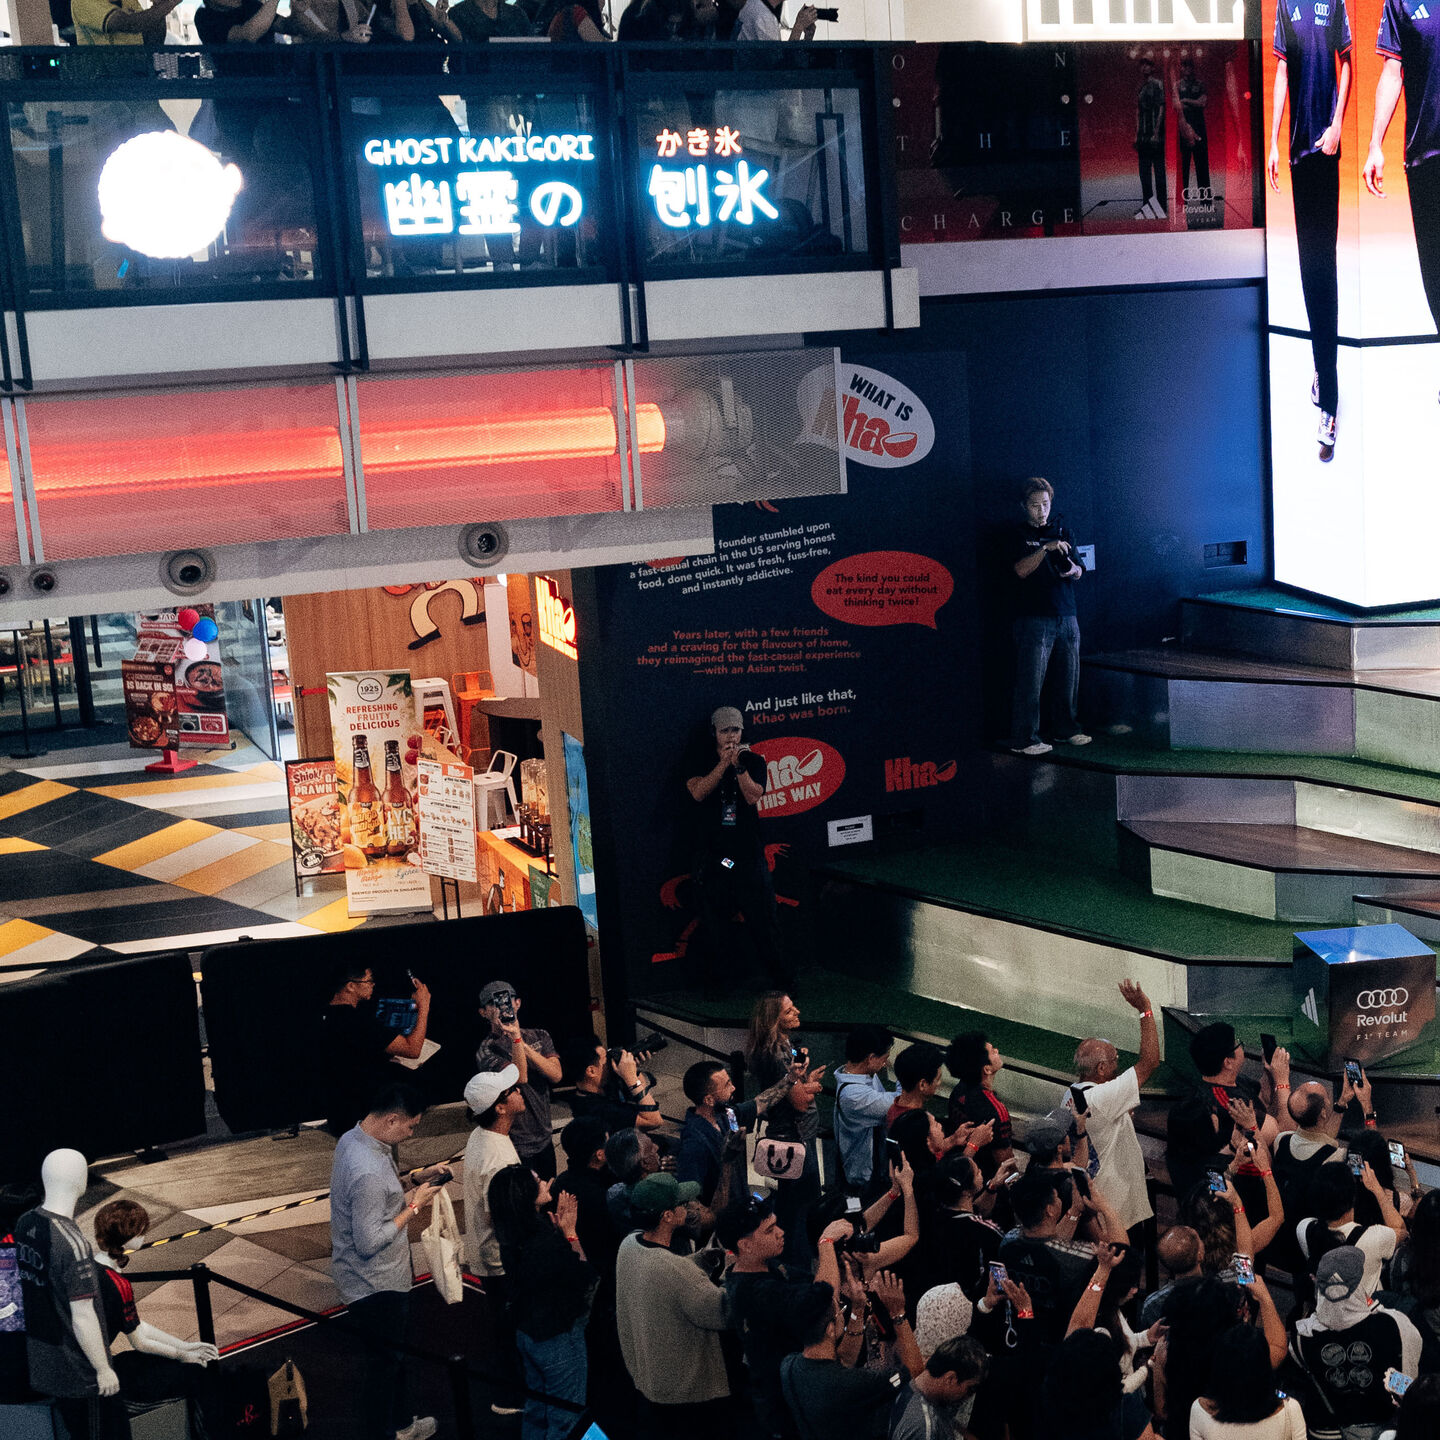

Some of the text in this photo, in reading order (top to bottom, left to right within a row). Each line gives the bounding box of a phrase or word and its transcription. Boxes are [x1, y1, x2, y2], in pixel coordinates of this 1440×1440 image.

[364, 134, 595, 166] GHOST KAKIGORI
[655, 125, 743, 157] かき氷
[384, 171, 584, 236] 幽霊の
[849, 372, 914, 422] WHAT IS
[718, 521, 831, 550] founder stumbled upon
[638, 561, 691, 578] fast-casual
[692, 553, 718, 567] chain
[719, 550, 729, 561] in
[731, 547, 748, 561] the
[749, 544, 764, 556] US
[766, 538, 802, 556] serving
[803, 532, 837, 547] honest
[637, 545, 832, 591] food, done quick. It was fresh, fuss-free,
[681, 565, 795, 596] and instantly addictive.
[834, 572, 930, 586] The kind you could
[826, 584, 938, 597] eat every day without
[843, 596, 920, 609] thinking twice!
[673, 630, 702, 641] Years
[704, 629, 732, 641] later,
[734, 628, 758, 639] with
[769, 627, 789, 638] few
[792, 626, 829, 638] friends
[647, 643, 669, 654] and
[679, 642, 720, 656] craving
[722, 641, 739, 652] for
[741, 640, 759, 651] the
[761, 639, 803, 650] flavours
[805, 638, 818, 648] of
[819, 637, 852, 649] home,
[637, 649, 861, 668] they reimagined the fast-casual experience
[730, 666, 744, 675] an
[746, 663, 776, 675] Asian
[778, 662, 808, 673] twist.
[360, 685, 380, 693] 1925
[346, 702, 399, 715] REFRESHING
[744, 687, 857, 713] And just like that,
[357, 712, 391, 722] FRUITY
[752, 705, 851, 726] Khao was born.
[349, 719, 400, 732] DELICIOUS
[292, 769, 323, 784] Shiok!
[293, 783, 334, 796] PRAWN
[756, 781, 822, 812] THIS WAY
[1356, 1010, 1408, 1028] Revolut
[1377, 1029, 1408, 1039] TEAM
